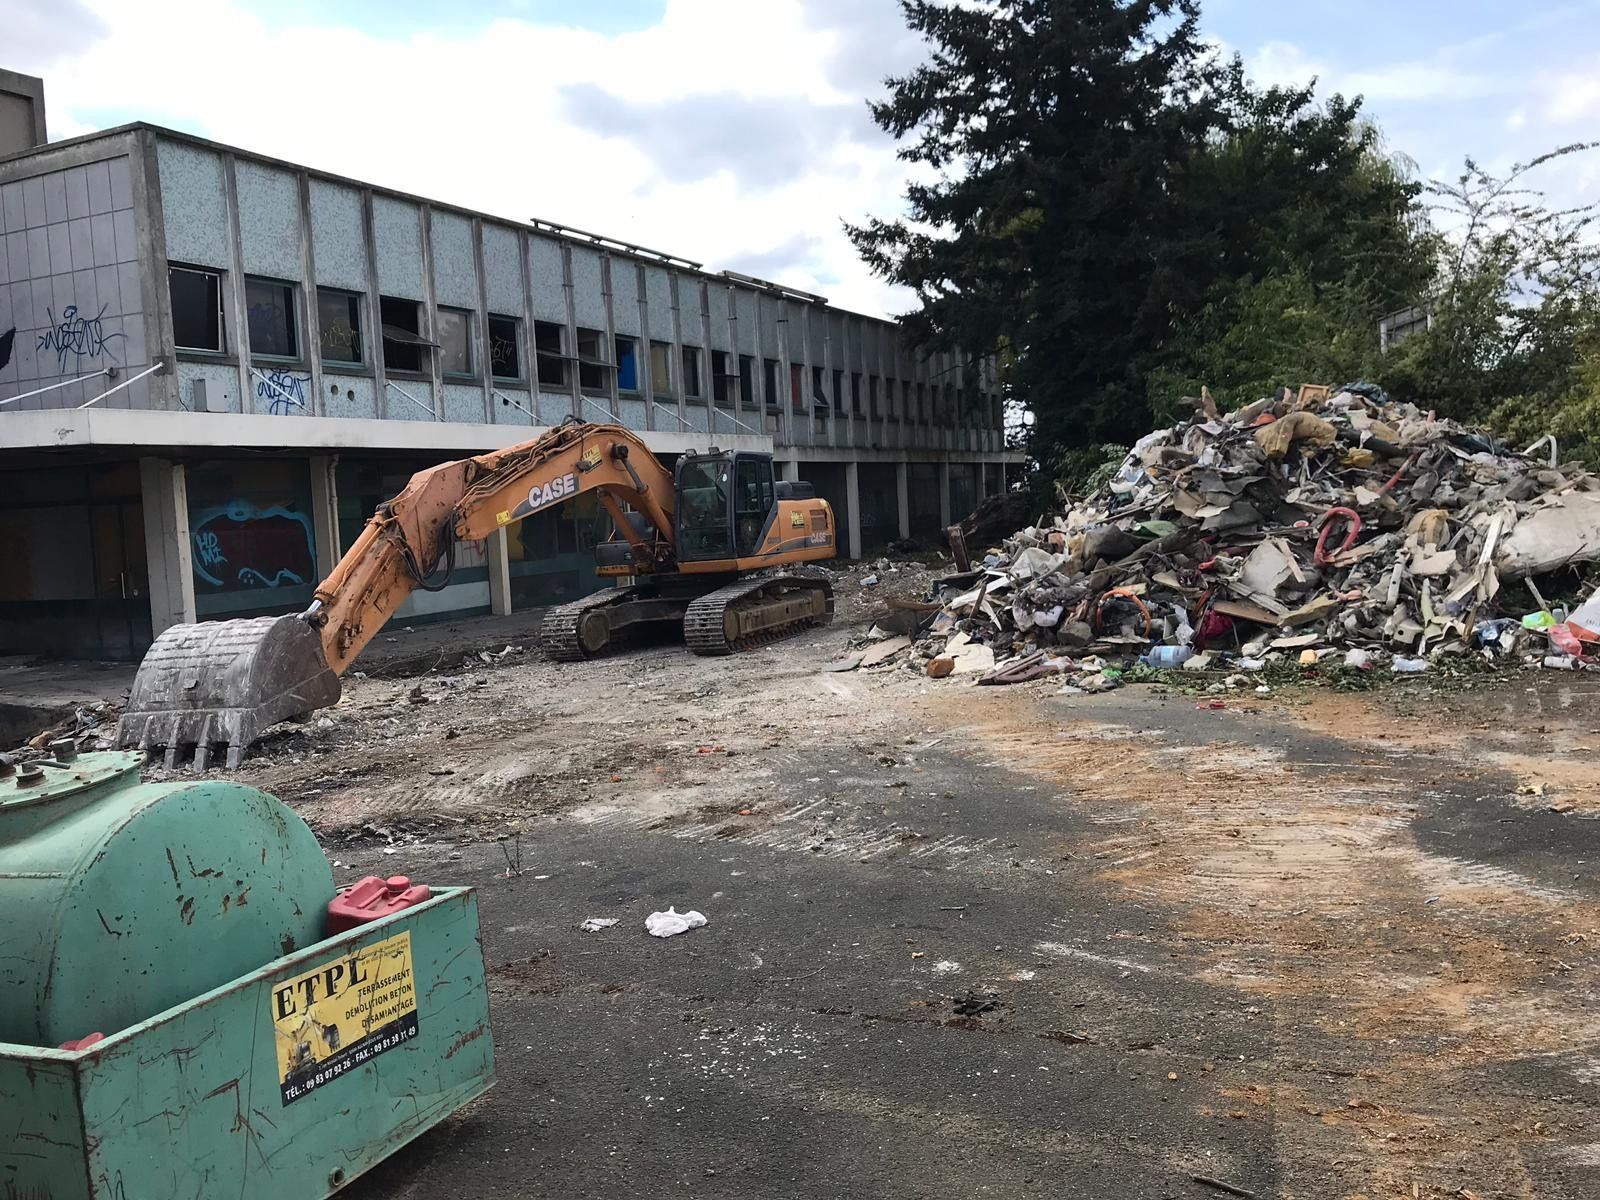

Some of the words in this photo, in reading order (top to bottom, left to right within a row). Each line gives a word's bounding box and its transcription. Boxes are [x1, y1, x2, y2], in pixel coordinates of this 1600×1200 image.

[527, 472, 575, 508] CASE
[810, 532, 826, 543] CASE
[274, 958, 367, 1021] ETPL
[358, 969, 410, 997] TERRASSEMENT
[306, 1079, 315, 1089] 09
[315, 1073, 324, 1084] 83
[324, 1068, 333, 1079] 07
[333, 1063, 342, 1075] 92
[342, 1058, 351, 1070] 26
[374, 1043, 382, 1052] 09
[382, 1038, 390, 1048] 81
[391, 1033, 399, 1045] 38
[408, 1026, 416, 1036] 49
